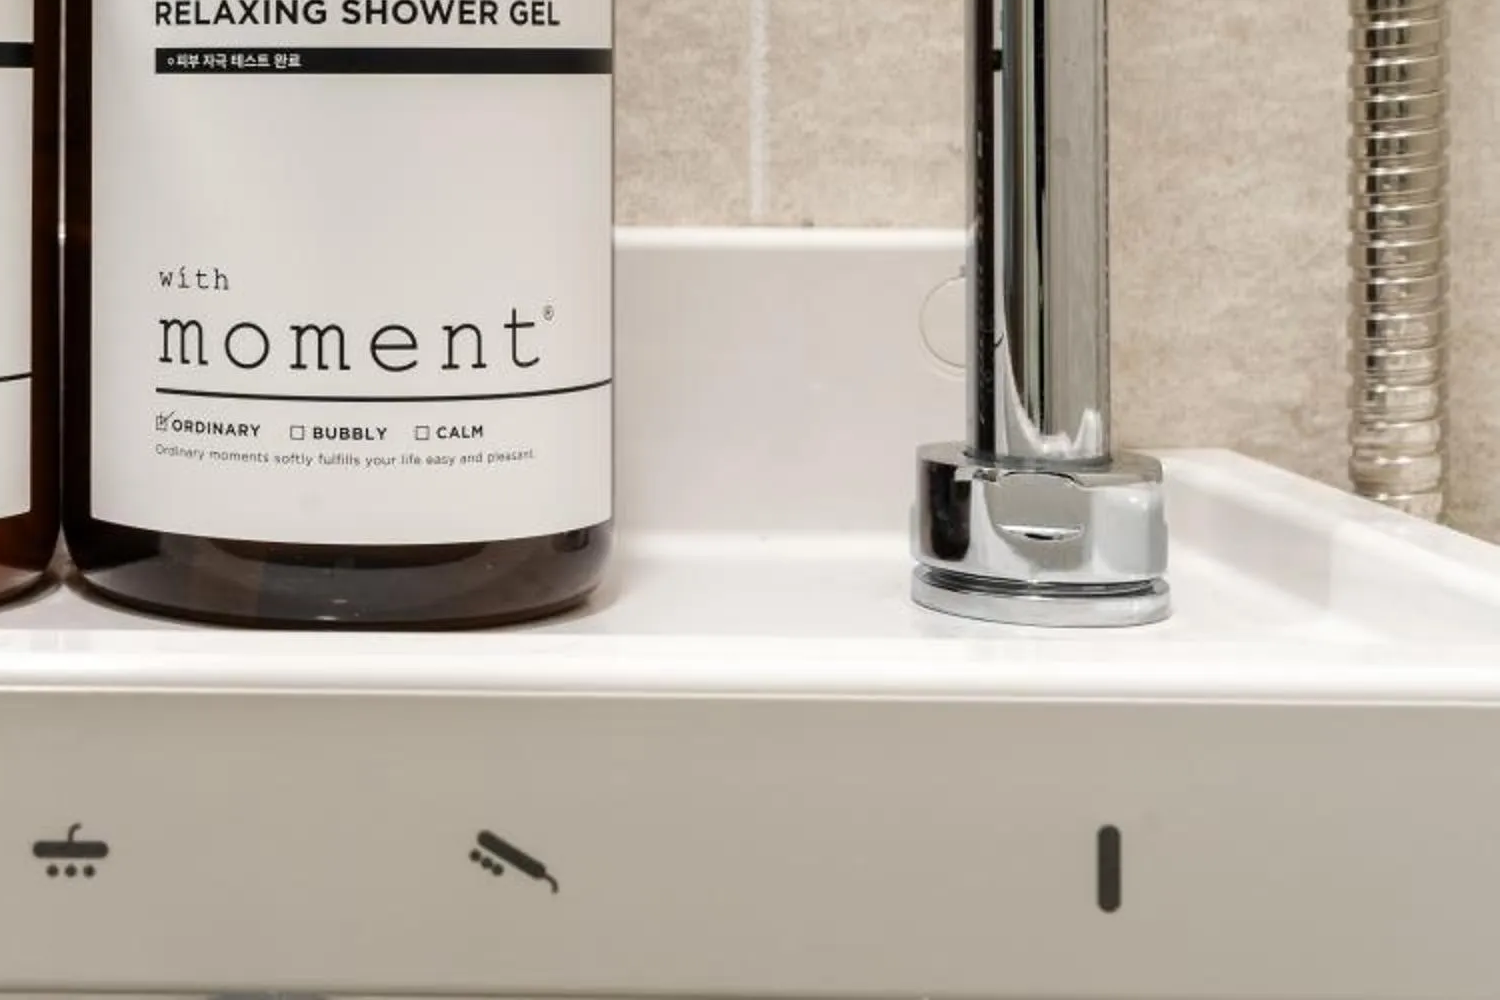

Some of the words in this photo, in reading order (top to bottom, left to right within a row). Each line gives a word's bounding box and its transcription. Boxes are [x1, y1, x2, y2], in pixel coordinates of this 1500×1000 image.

[508, 0, 561, 27] GEL
[171, 418, 262, 438] ORDINARY
[312, 425, 388, 441] BUBBLY
[435, 424, 484, 440] CALM
[209, 448, 269, 463] moments
[274, 452, 313, 467] softly
[318, 452, 361, 466] fulfills
[365, 456, 397, 468] your
[401, 452, 422, 465] life
[425, 455, 457, 467] easy
[460, 452, 483, 465] and
